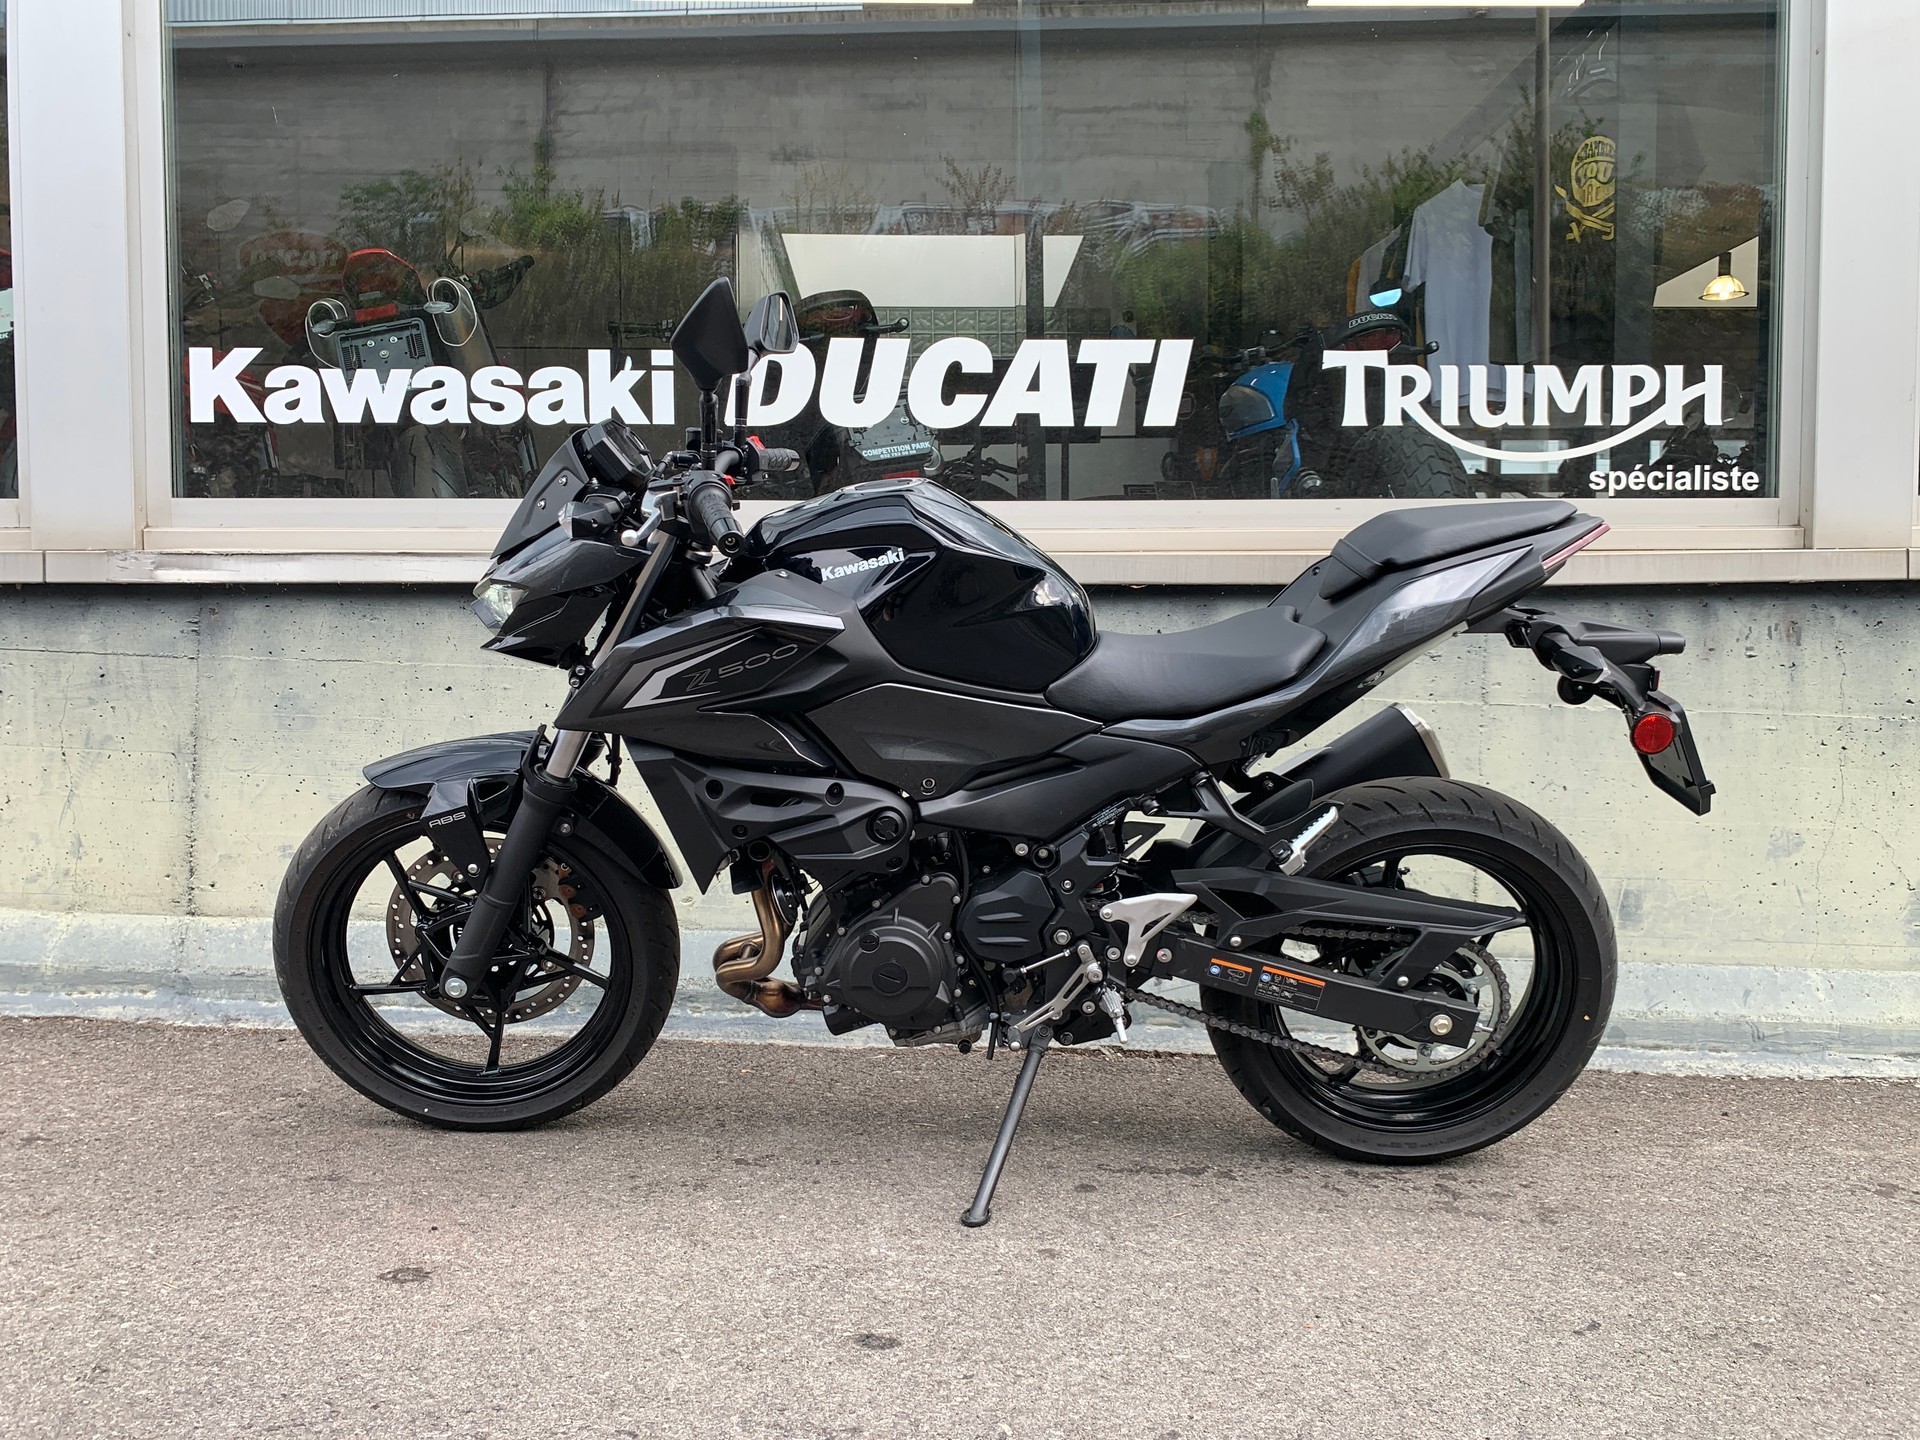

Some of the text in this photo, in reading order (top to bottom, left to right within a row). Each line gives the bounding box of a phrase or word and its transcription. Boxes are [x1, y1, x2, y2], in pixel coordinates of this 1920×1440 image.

[188, 348, 675, 425] Kawasaki
[724, 337, 1194, 428] DUCATI
[1322, 349, 1723, 461] TRIUMPH
[862, 441, 931, 457] COMPETITION PARK
[1588, 463, 1760, 495] spécialiste
[821, 547, 905, 581] Kawasaki
[682, 643, 799, 692] Z500
[428, 811, 467, 828] ABS
